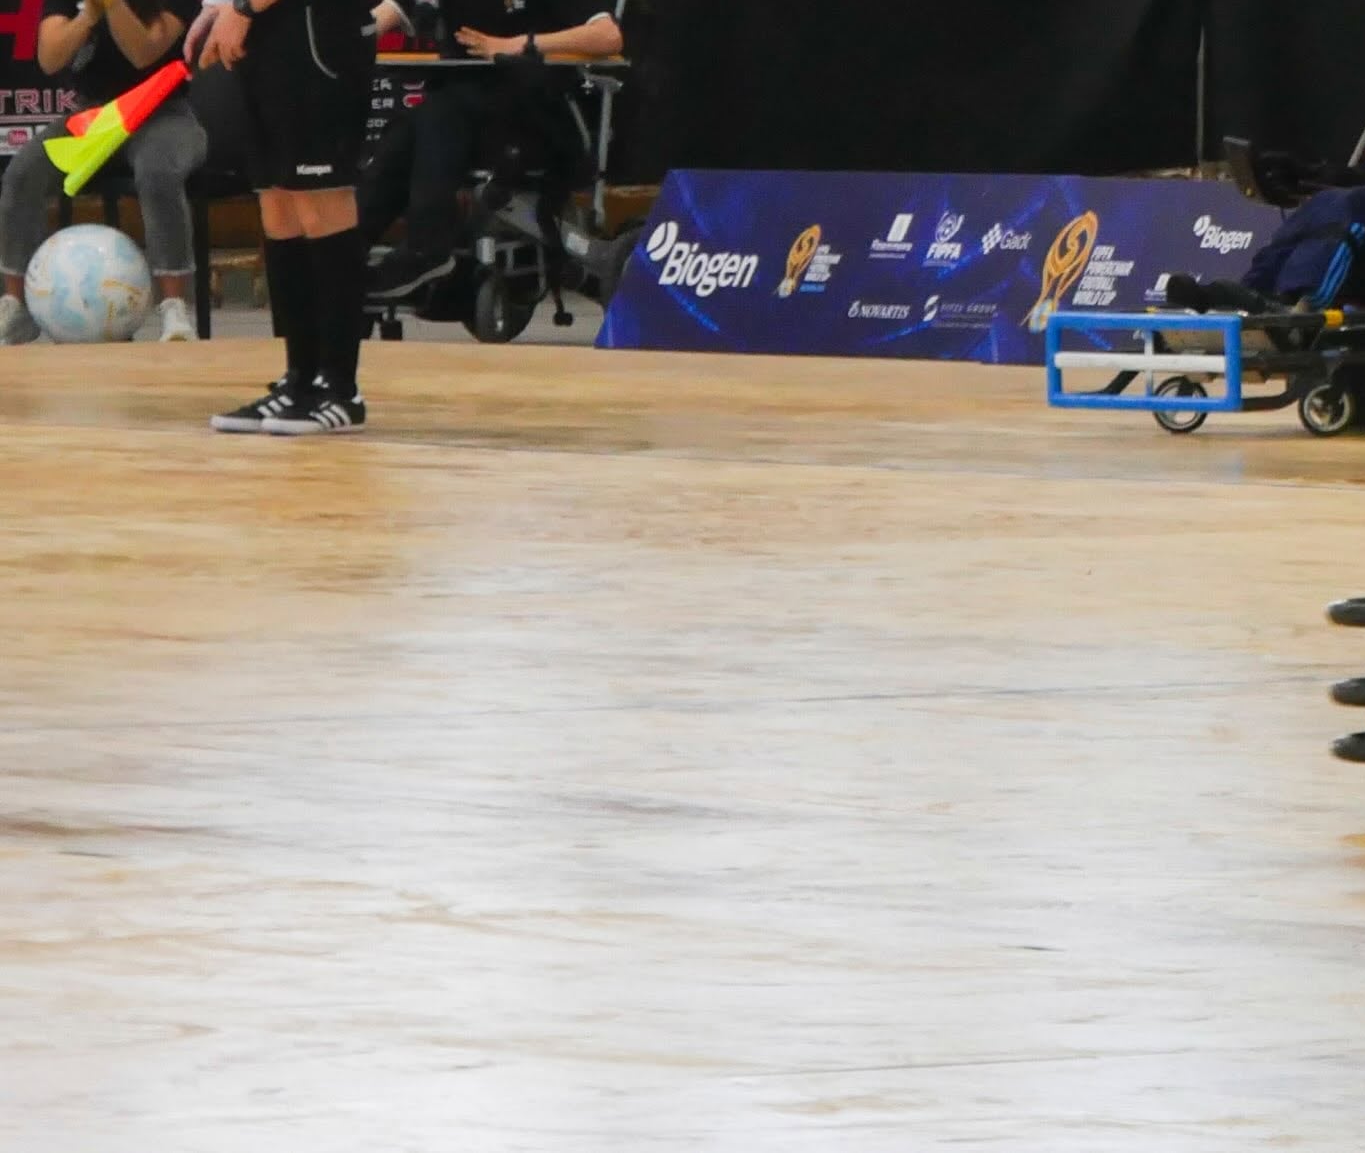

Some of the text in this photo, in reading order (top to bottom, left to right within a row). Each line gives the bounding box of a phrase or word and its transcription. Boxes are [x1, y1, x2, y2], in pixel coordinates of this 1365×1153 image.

[1200, 224, 1253, 255] Biogen
[658, 242, 759, 297] Biogen
[859, 303, 911, 320] NOVARTIS
